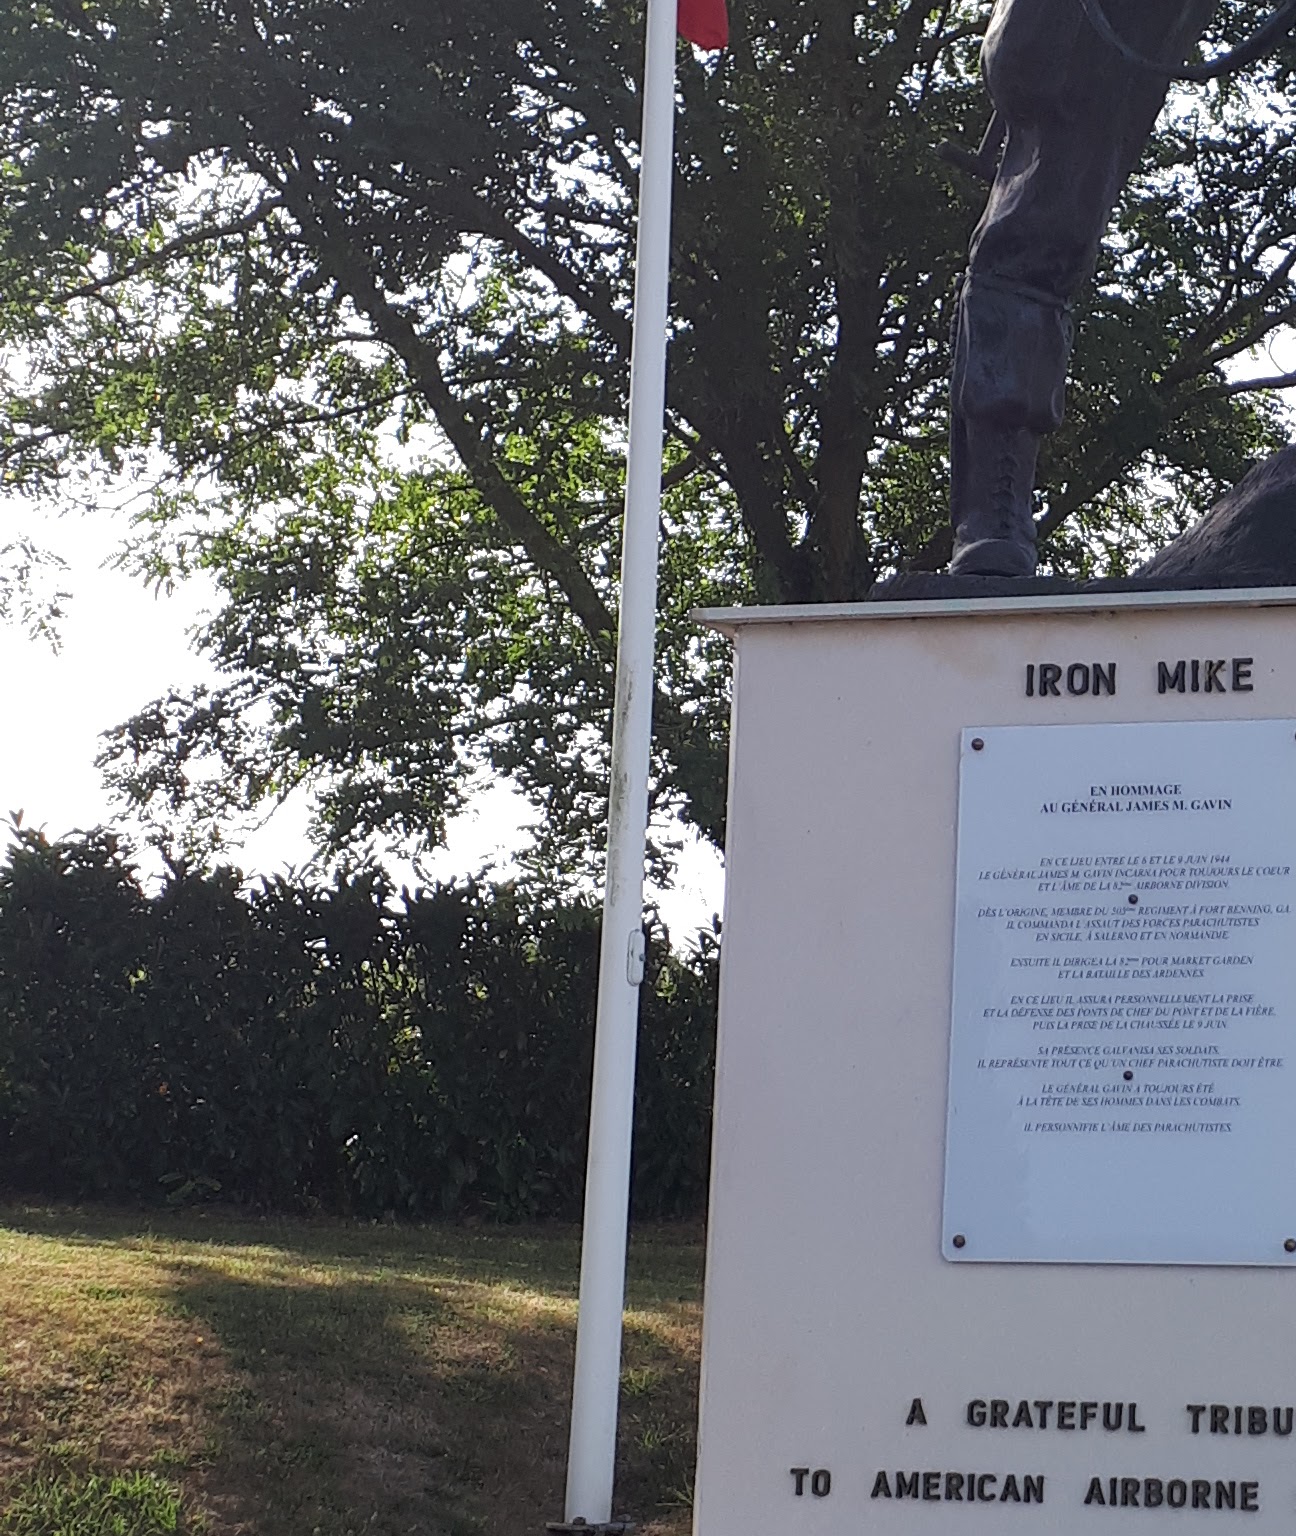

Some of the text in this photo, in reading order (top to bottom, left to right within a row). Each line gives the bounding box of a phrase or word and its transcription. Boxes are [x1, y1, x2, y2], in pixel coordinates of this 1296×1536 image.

[1026, 658, 1254, 696] IRON MIKE
[1090, 785, 1182, 796] EN HOMMAGE
[1040, 800, 1232, 813] AU GÉNÉRAL JAMES M. GAVIN
[1040, 857, 1051, 866] EN
[1055, 857, 1068, 866] CE
[1070, 857, 1092, 866] LIEU
[1095, 856, 1125, 865] ENTRE
[1128, 856, 1139, 865] LE
[1150, 856, 1161, 865] ET
[1163, 856, 1176, 865] LE
[1185, 856, 1207, 864] JUIN
[1210, 856, 1230, 864] 1944
[979, 870, 991, 879] LE
[992, 868, 1036, 879] GÉNÉRAL
[1038, 869, 1068, 879] JAMES
[1083, 869, 1113, 878] GAVIN
[1115, 868, 1157, 878] INCARNA
[1159, 868, 1186, 877] POUR
[1190, 867, 1240, 877] TOUJOURS
[1241, 867, 1254, 876] LE
[1256, 867, 1290, 876] COEUR
[1038, 882, 1051, 891] ET
[1083, 882, 1096, 890] DE
[1099, 882, 1110, 890] LA
[978, 907, 996, 917] DÈS
[1050, 907, 1092, 916] MEMBRE
[1095, 907, 1108, 916] DU
[1199, 905, 1226, 914] FORT
[1005, 921, 1015, 929] IL
[1017, 921, 1073, 929] COMMANDA
[1122, 920, 1140, 928] DES
[1143, 919, 1180, 928] FORCES
[1183, 918, 1260, 927] PARACHUTISTES
[1036, 933, 1049, 941] EN
[1094, 932, 1137, 940] SALERNO
[1140, 932, 1152, 940] ET
[1154, 932, 1166, 940] EN
[1010, 958, 1050, 966] ENSUITE
[1052, 958, 1060, 966] IL
[1105, 957, 1117, 966] LA
[1141, 957, 1169, 965] POUR
[1171, 957, 1212, 965] MARKET
[1213, 956, 1254, 965] GARDEN
[1058, 970, 1071, 978] ET
[1072, 970, 1083, 978] LA
[1086, 970, 1130, 978] BATAILLE
[1131, 969, 1151, 978] DES
[1010, 996, 1024, 1004] EN
[1025, 996, 1039, 1004] CE
[1040, 996, 1062, 1004] LIEU
[1065, 996, 1073, 1004] IL
[1076, 995, 1112, 1004] ASSURA
[1212, 995, 1223, 1003] LA
[1226, 995, 1253, 1003] PRISE
[983, 1008, 995, 1017] ET
[997, 1008, 1009, 1017] LA
[1010, 1007, 1053, 1017] DÉFENSE
[1055, 1008, 1074, 1017] DES
[1077, 1008, 1107, 1017] PONTS
[1110, 1008, 1124, 1017] DE
[1126, 1008, 1151, 1016] CHEF
[1155, 1008, 1170, 1016] DU
[1172, 1007, 1200, 1016] PONT
[1201, 1007, 1213, 1016] ET
[1215, 1007, 1229, 1016] DE
[1231, 1007, 1243, 1016] LA
[1033, 1021, 1055, 1029] PUIS
[1057, 1021, 1069, 1029] LA
[1070, 1021, 1098, 1029] PRISE
[1100, 1021, 1114, 1029] DE
[1115, 1021, 1127, 1029] LA
[1182, 1020, 1194, 1029] LE
[1038, 1046, 1049, 1055] SA
[1051, 1045, 1100, 1055] PRÉSENCE
[1157, 1046, 1174, 1054] SES
[977, 1059, 986, 1068] IL
[1051, 1059, 1077, 1068] TOUT
[1079, 1059, 1092, 1068] CE
[1129, 1059, 1155, 1068] CHEF
[1157, 1059, 1230, 1068] PARACHUTISTE
[1231, 1059, 1256, 1068] DOIT
[1042, 1085, 1053, 1094] LE
[1103, 1085, 1132, 1094] GAVIN
[1144, 1085, 1195, 1094] TOUJOURS
[1026, 1097, 1038, 1106] LA
[1066, 1097, 1078, 1106] DE
[1081, 1097, 1099, 1106] SES
[1101, 1097, 1143, 1106] HOMMES
[1146, 1097, 1171, 1106] DANS
[1174, 1097, 1191, 1106] LES
[1024, 1123, 1033, 1132] IL
[1132, 1123, 1152, 1132] DES
[906, 1399, 928, 1426] A
[966, 1399, 1146, 1433] GRATEFUL
[790, 1468, 832, 1498] TO
[871, 1470, 1045, 1505] AMERICAN
[1085, 1477, 1260, 1512] AIRBORNE
